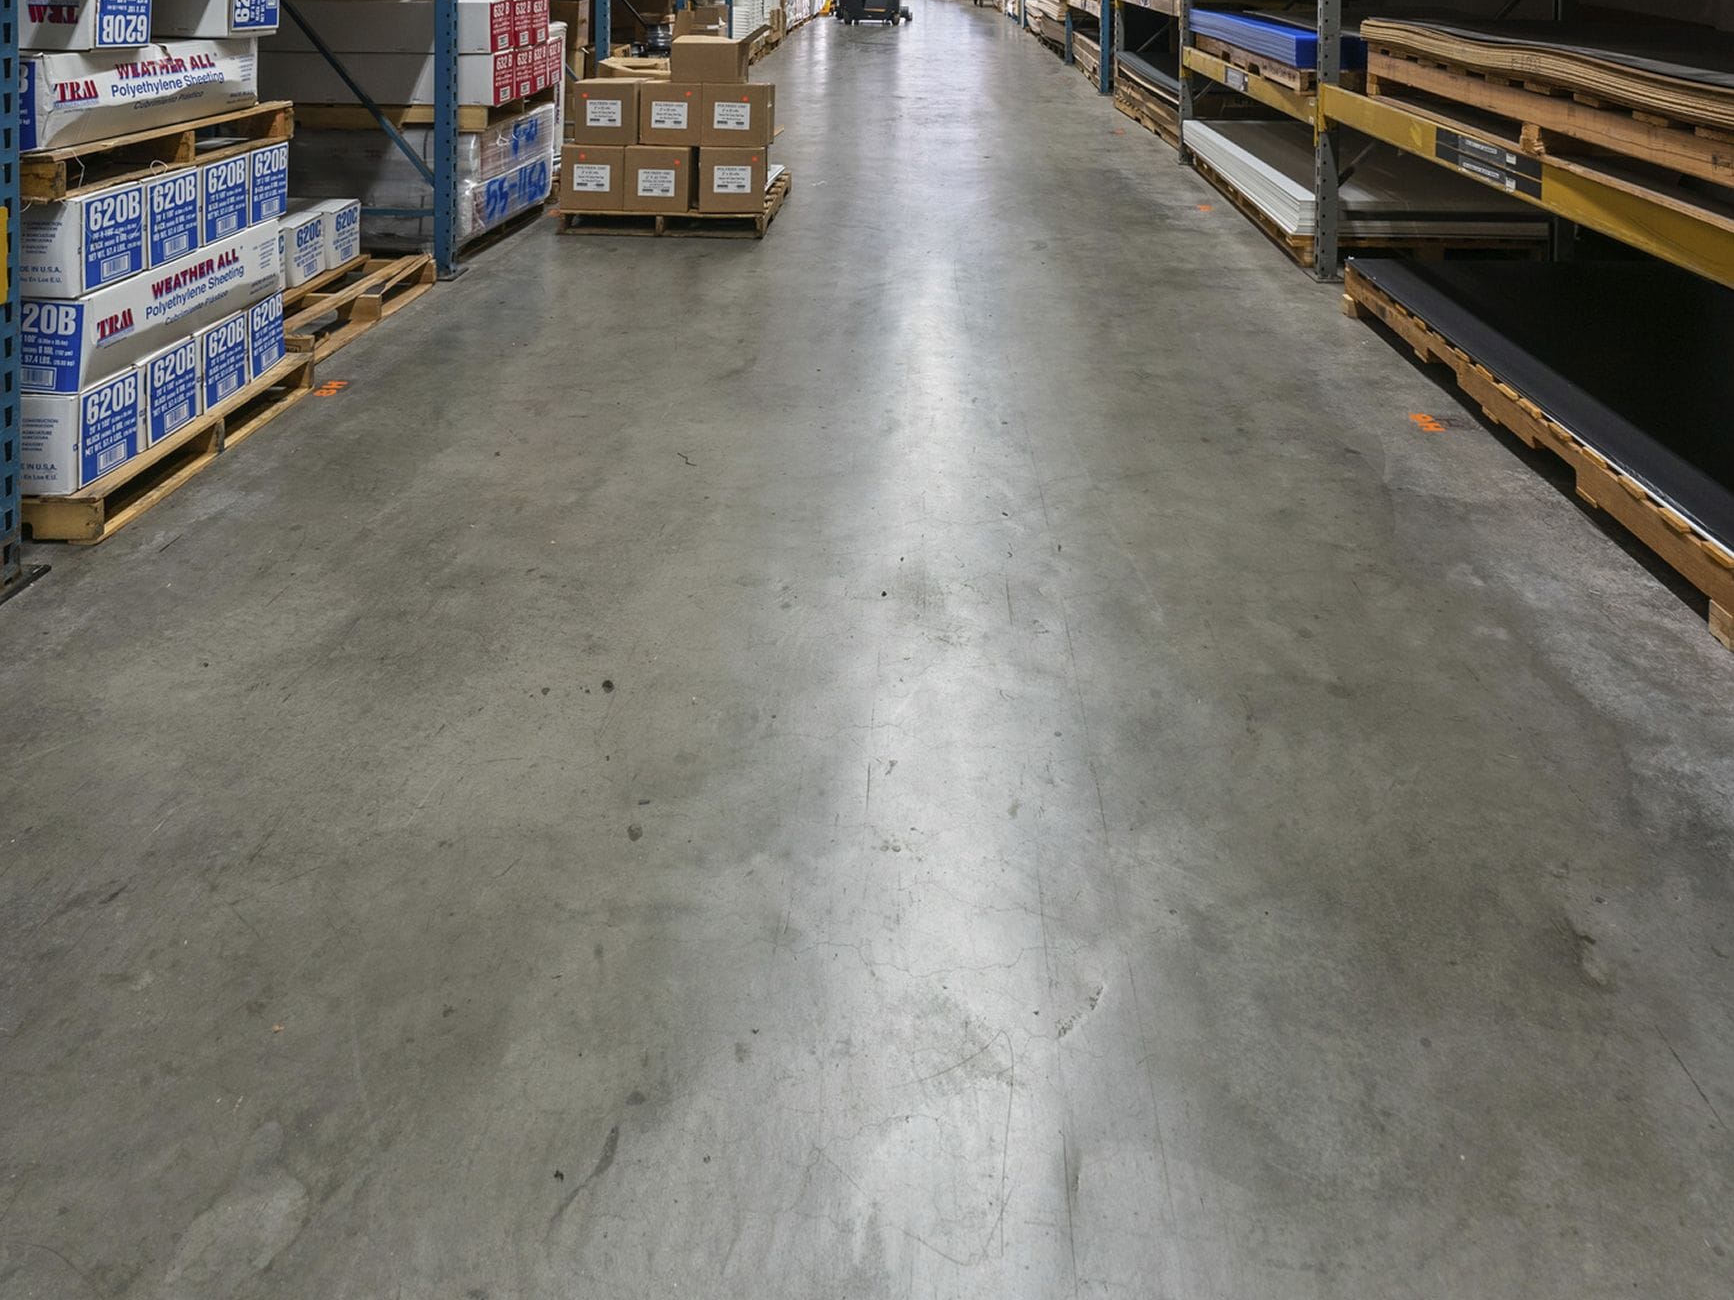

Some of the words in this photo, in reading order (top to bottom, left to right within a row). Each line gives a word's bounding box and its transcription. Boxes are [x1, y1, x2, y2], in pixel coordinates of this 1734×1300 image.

[493, 2, 504, 18] 632
[102, 14, 147, 43] 620B
[114, 56, 187, 80] WEATHER
[188, 53, 215, 70] ALL
[496, 55, 507, 70] 632
[54, 79, 99, 103] TRM
[111, 79, 183, 98] Polyethylene
[184, 70, 225, 88] Sheeting
[208, 159, 244, 194] 620B
[254, 147, 287, 177] 620B
[90, 191, 140, 231] 620B
[154, 175, 195, 214] 620B
[297, 219, 321, 248] 620C
[336, 207, 358, 232] 620C
[152, 259, 214, 300] WEATHER
[217, 249, 239, 271] ALL
[145, 283, 206, 320] Polyethylene
[208, 265, 245, 290] Sheeting
[22, 302, 77, 336] 20B
[97, 308, 134, 340] TRM
[253, 293, 283, 331] 620B
[208, 317, 245, 358] 620B
[154, 343, 195, 388] 620B
[86, 376, 136, 425] 620B
